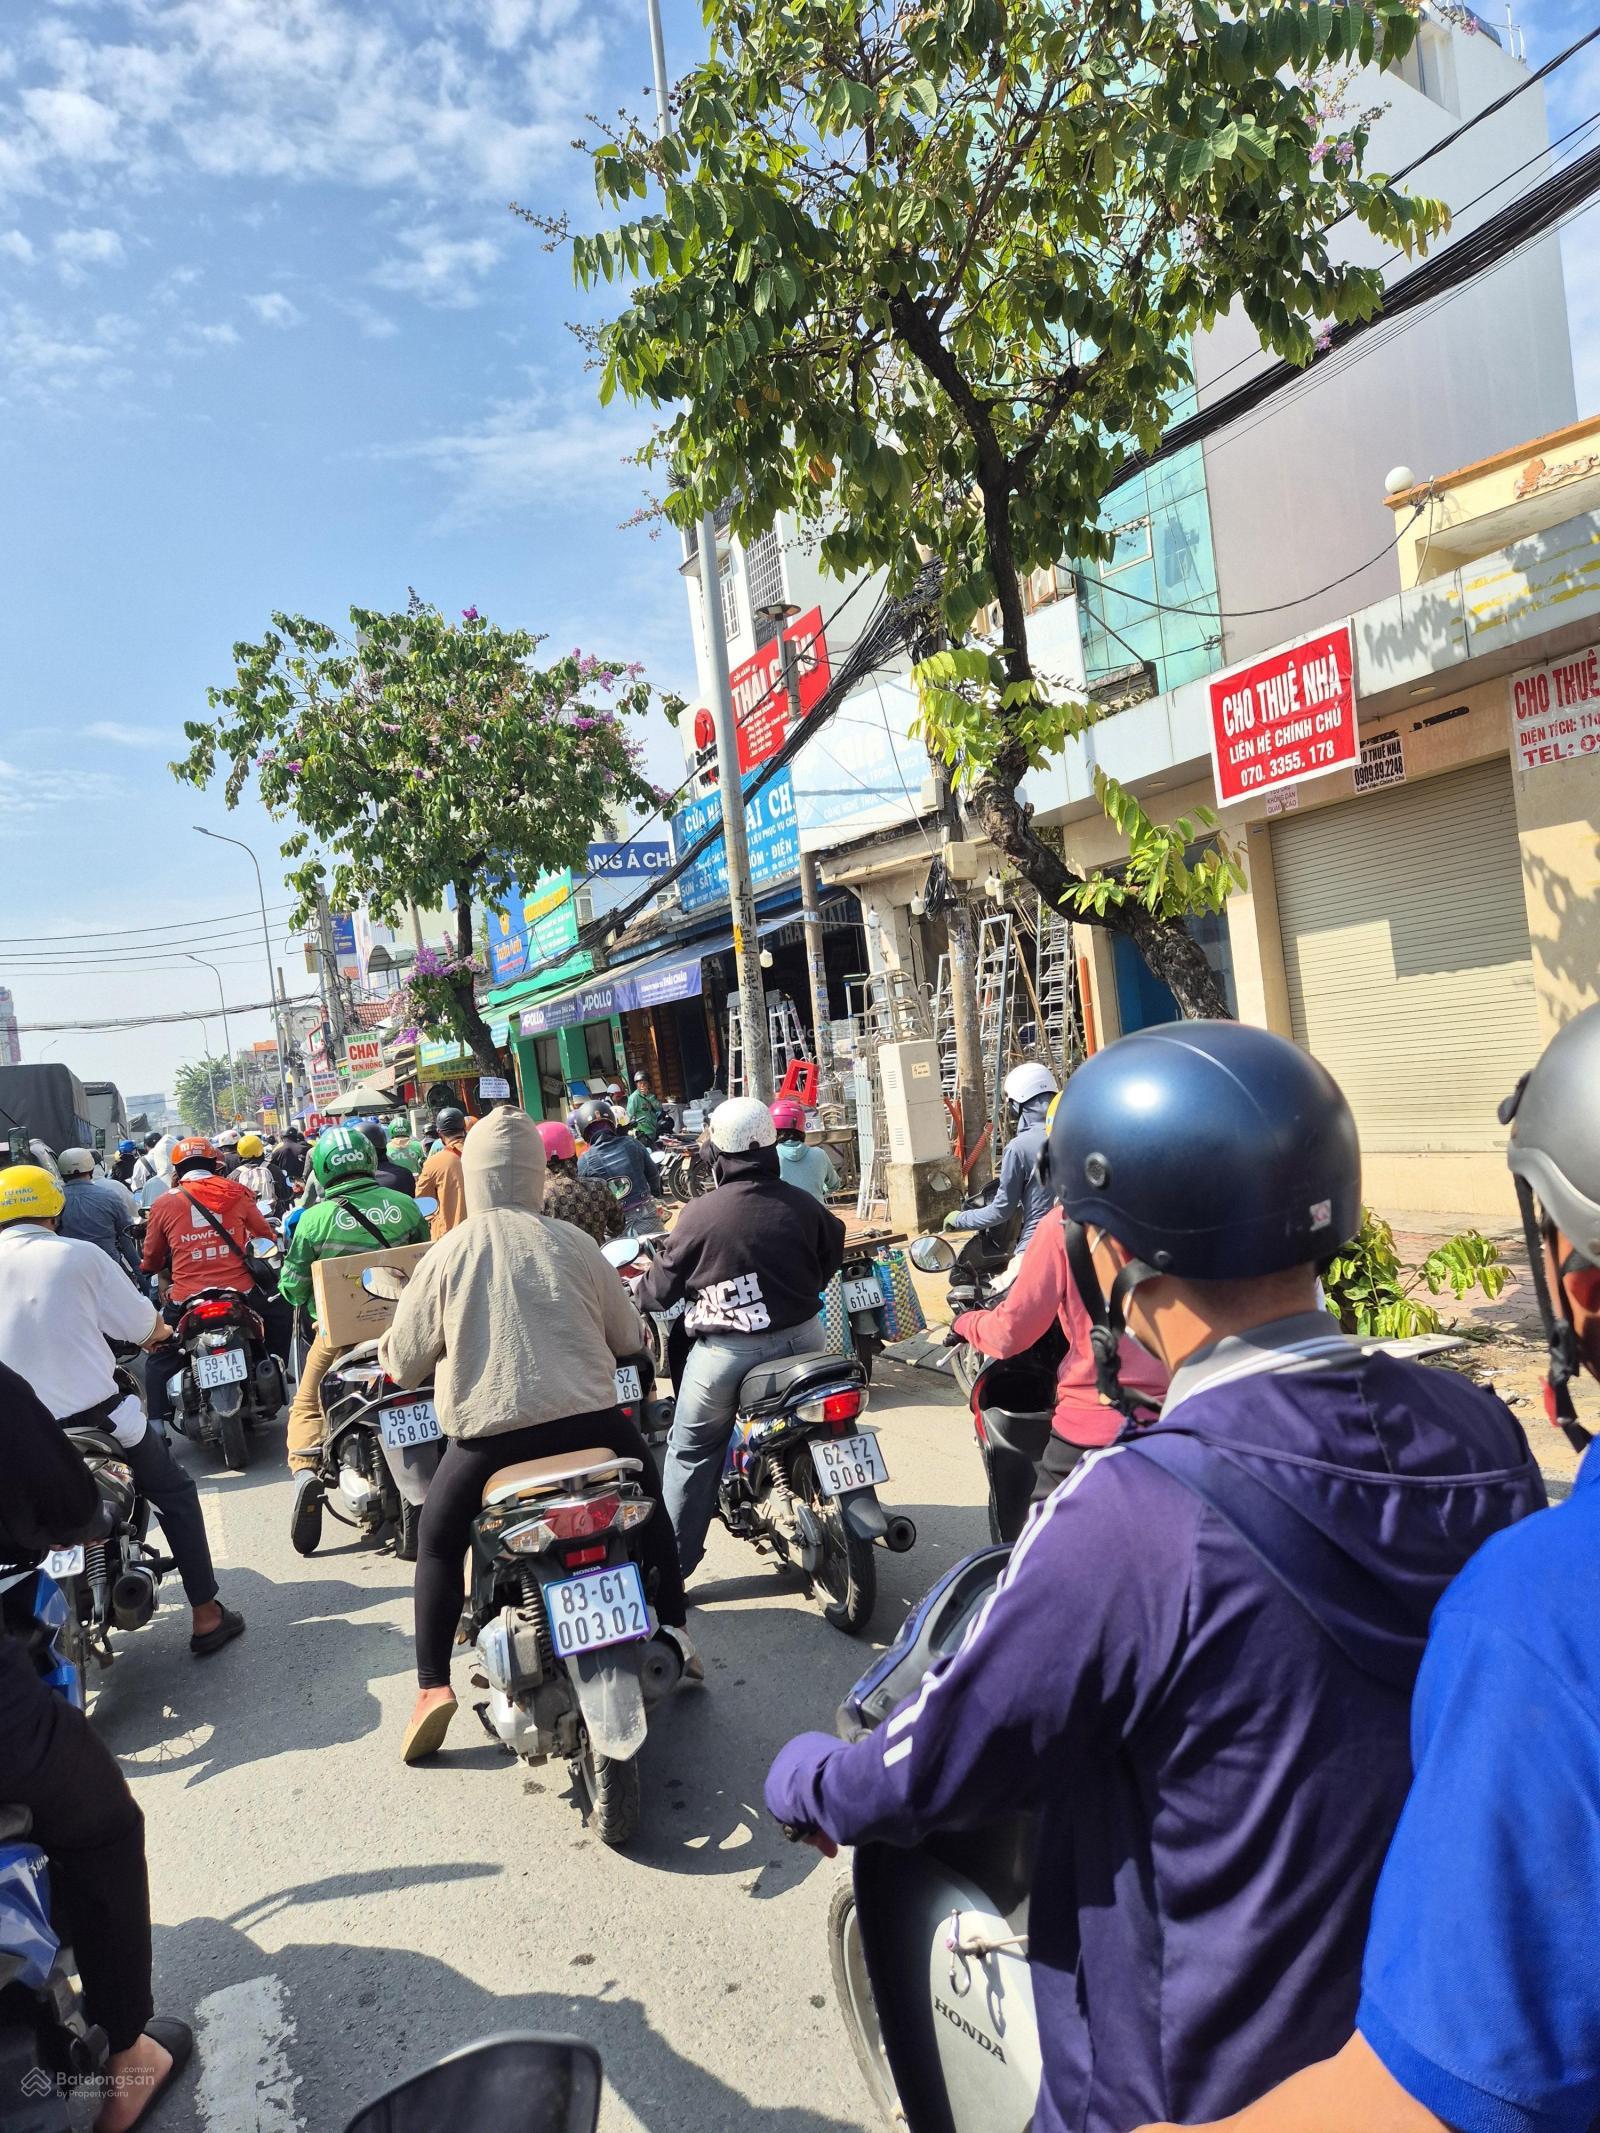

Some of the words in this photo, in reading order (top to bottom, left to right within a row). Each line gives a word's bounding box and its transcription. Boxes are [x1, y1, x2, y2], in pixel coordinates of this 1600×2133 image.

[1222, 687, 1255, 737] CHO
[1256, 660, 1300, 724] THUÊ
[1302, 645, 1343, 708] NHÀ
[1514, 673, 1550, 720] CHO
[1552, 649, 1600, 708] THUÊ
[1229, 741, 1256, 765] LIÊN
[1256, 730, 1272, 756] HỆ
[1274, 718, 1313, 748] CHÍNH
[1315, 702, 1342, 733] CHỦ
[1520, 726, 1546, 746] DIỆN
[1548, 718, 1577, 738] TÍCH:
[1241, 764, 1266, 787] 070.
[1270, 751, 1306, 777] 3355.
[1309, 739, 1335, 764] 178
[1368, 744, 1387, 763] THUÊ
[1523, 743, 1574, 767] TEL:
[685, 806, 706, 833] CỬA
[706, 796, 722, 822] HÀ
[768, 782, 797, 819] CH
[626, 848, 641, 869] Á
[642, 851, 671, 869] CH
[582, 990, 612, 1012] APOLLO
[348, 1042, 379, 1061] CHAY
[330, 1149, 365, 1166] Grab
[335, 1200, 403, 1231] Grab
[180, 1226, 235, 1243] NowFod
[854, 1281, 868, 1294] 54
[850, 1291, 881, 1309] 611.LB
[205, 1353, 238, 1372] 59-YA
[205, 1366, 243, 1386] 154.15
[616, 1368, 632, 1384] S2
[389, 1404, 431, 1427] 59-G2
[388, 1420, 439, 1446] 468.09
[822, 1437, 872, 1466] 62-F2
[830, 1459, 876, 1490] 9087
[572, 1565, 601, 1577] HONDA
[560, 1571, 626, 1615] 83-G1
[558, 1601, 644, 1650] 003.02
[934, 1995, 1007, 2065] HONDA
